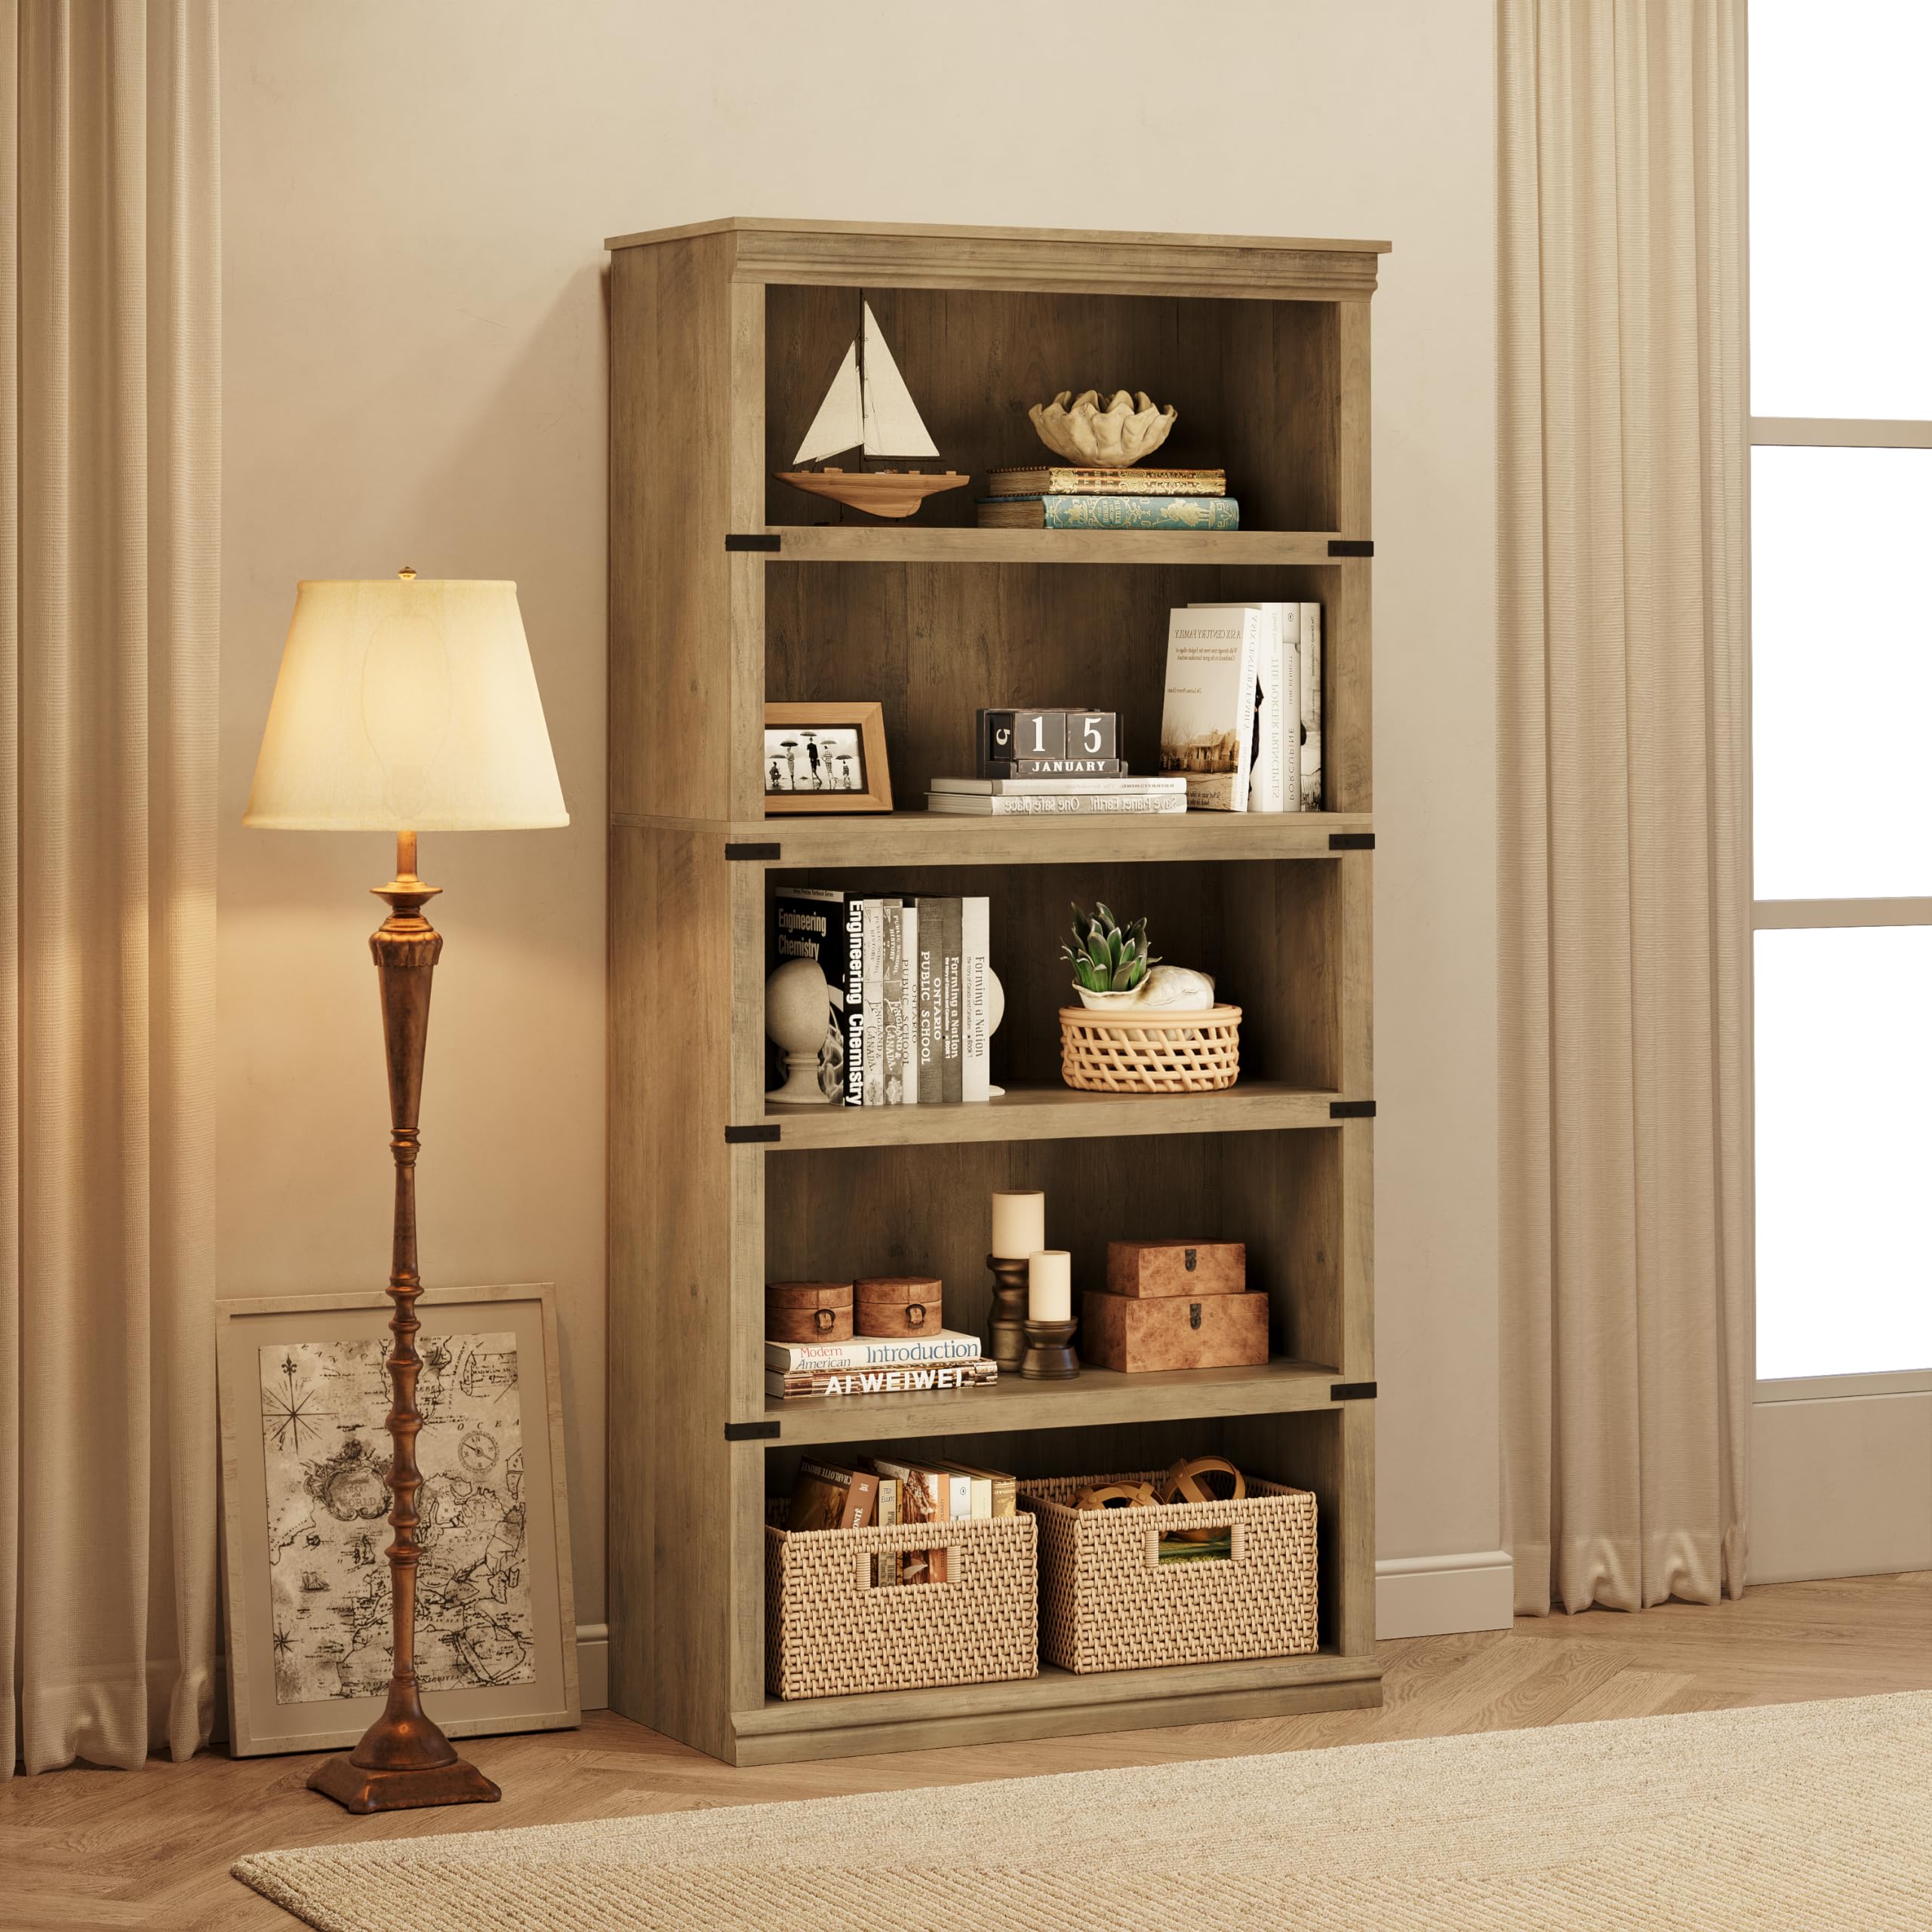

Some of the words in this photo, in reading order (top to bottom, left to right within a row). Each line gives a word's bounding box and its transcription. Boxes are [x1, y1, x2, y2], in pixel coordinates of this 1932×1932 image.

[1032, 760, 1106, 773] JANUARY
[778, 908, 826, 937] Engineering
[893, 915, 901, 943] PUBLIC
[778, 934, 820, 961] Chemistry
[846, 900, 864, 1004] Engineering
[893, 944, 901, 975] SCHOOL
[921, 951, 930, 1001] PUBLIC
[949, 956, 959, 1008] Forming
[973, 956, 985, 1007] Forming
[933, 977, 941, 1041] ONTARIO
[921, 1009, 930, 1065] SCHOOL
[951, 1020, 959, 1058] Nation
[975, 1020, 986, 1057] Nation
[847, 1013, 864, 1106] Chemistry
[796, 1357, 851, 1371] American
[800, 1346, 843, 1358] Modern
[866, 1340, 979, 1364] Introduction
[824, 1376, 852, 1395] AI
[821, 1467, 852, 1485] CHARLOTTE
